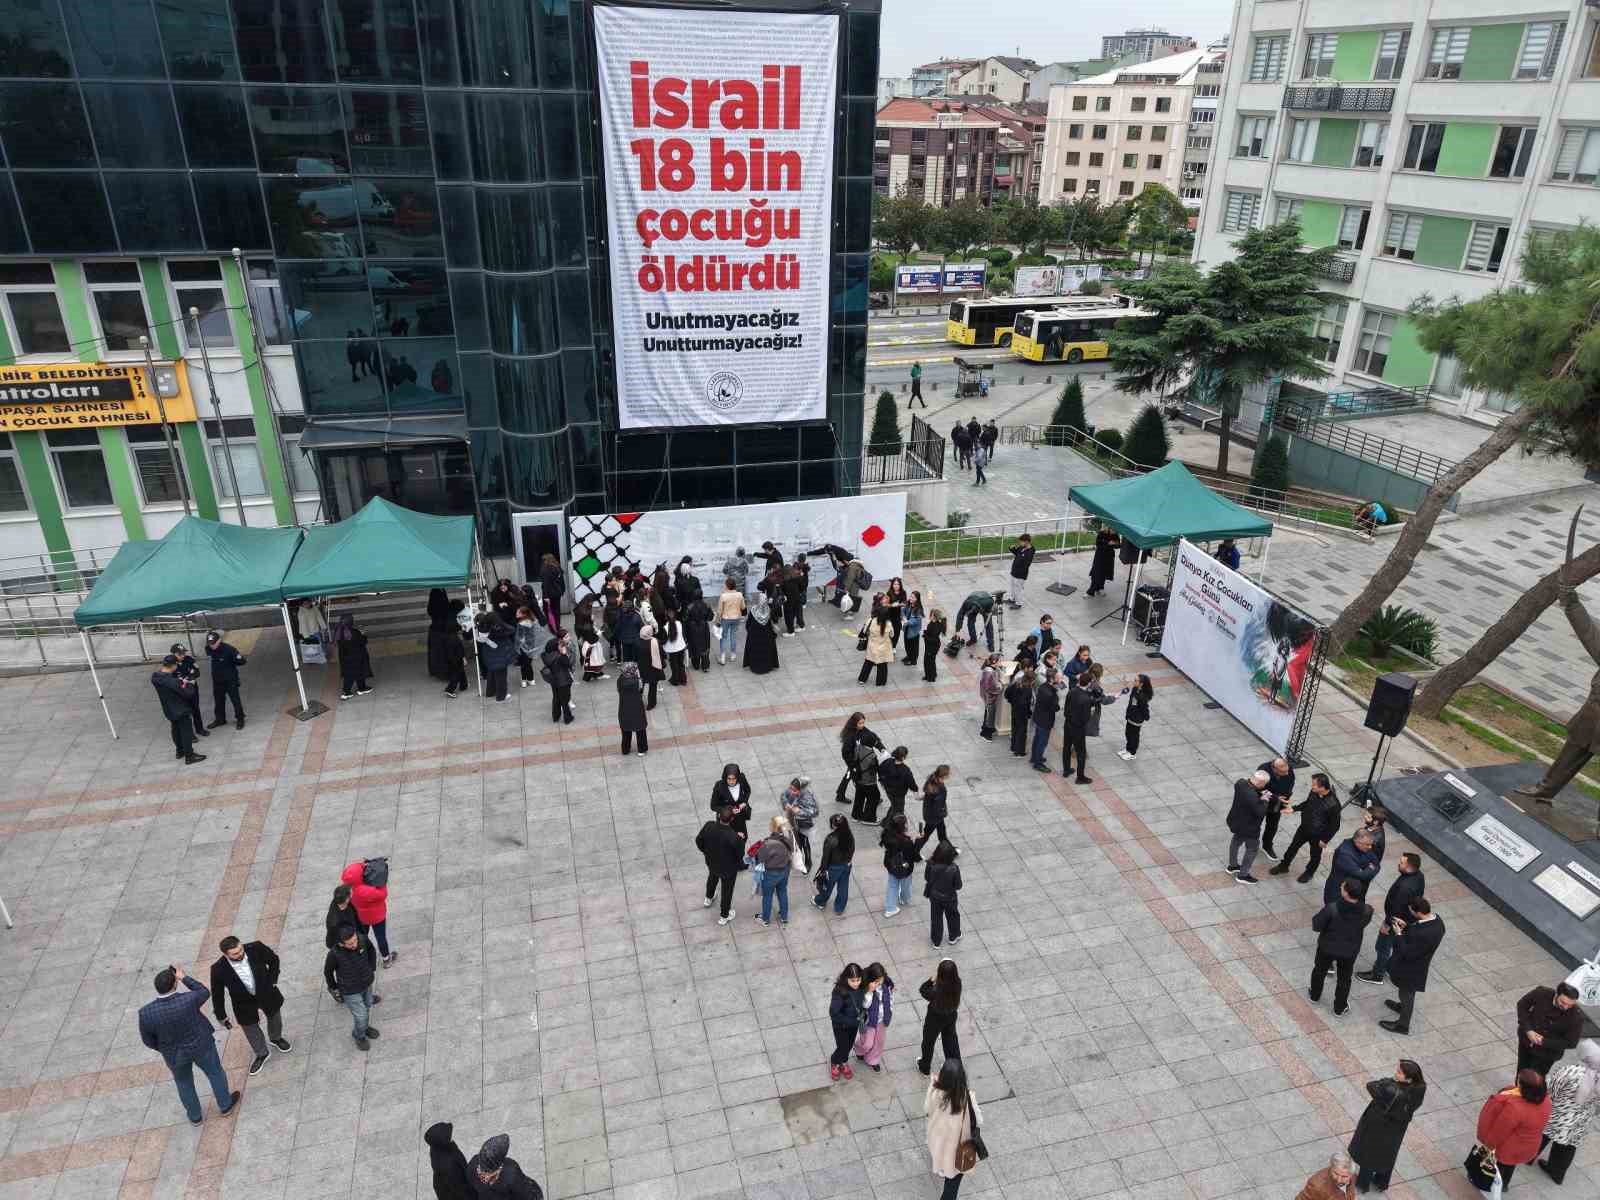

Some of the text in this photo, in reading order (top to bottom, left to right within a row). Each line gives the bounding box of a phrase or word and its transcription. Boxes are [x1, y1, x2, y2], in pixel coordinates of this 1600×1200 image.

[630, 138, 801, 192] 18 bin
[636, 198, 801, 249] çocuğu
[638, 254, 801, 293] öldürdü
[646, 308, 800, 332] Unutmayacağız
[643, 333, 803, 353] Unutturmayacağız!
[0, 366, 128, 381] HİR BELEDİYESİ
[0, 401, 125, 417] PAŞA SAHNESİ
[13, 415, 73, 429] ÇOCUK
[79, 410, 151, 423] SAHNESİ
